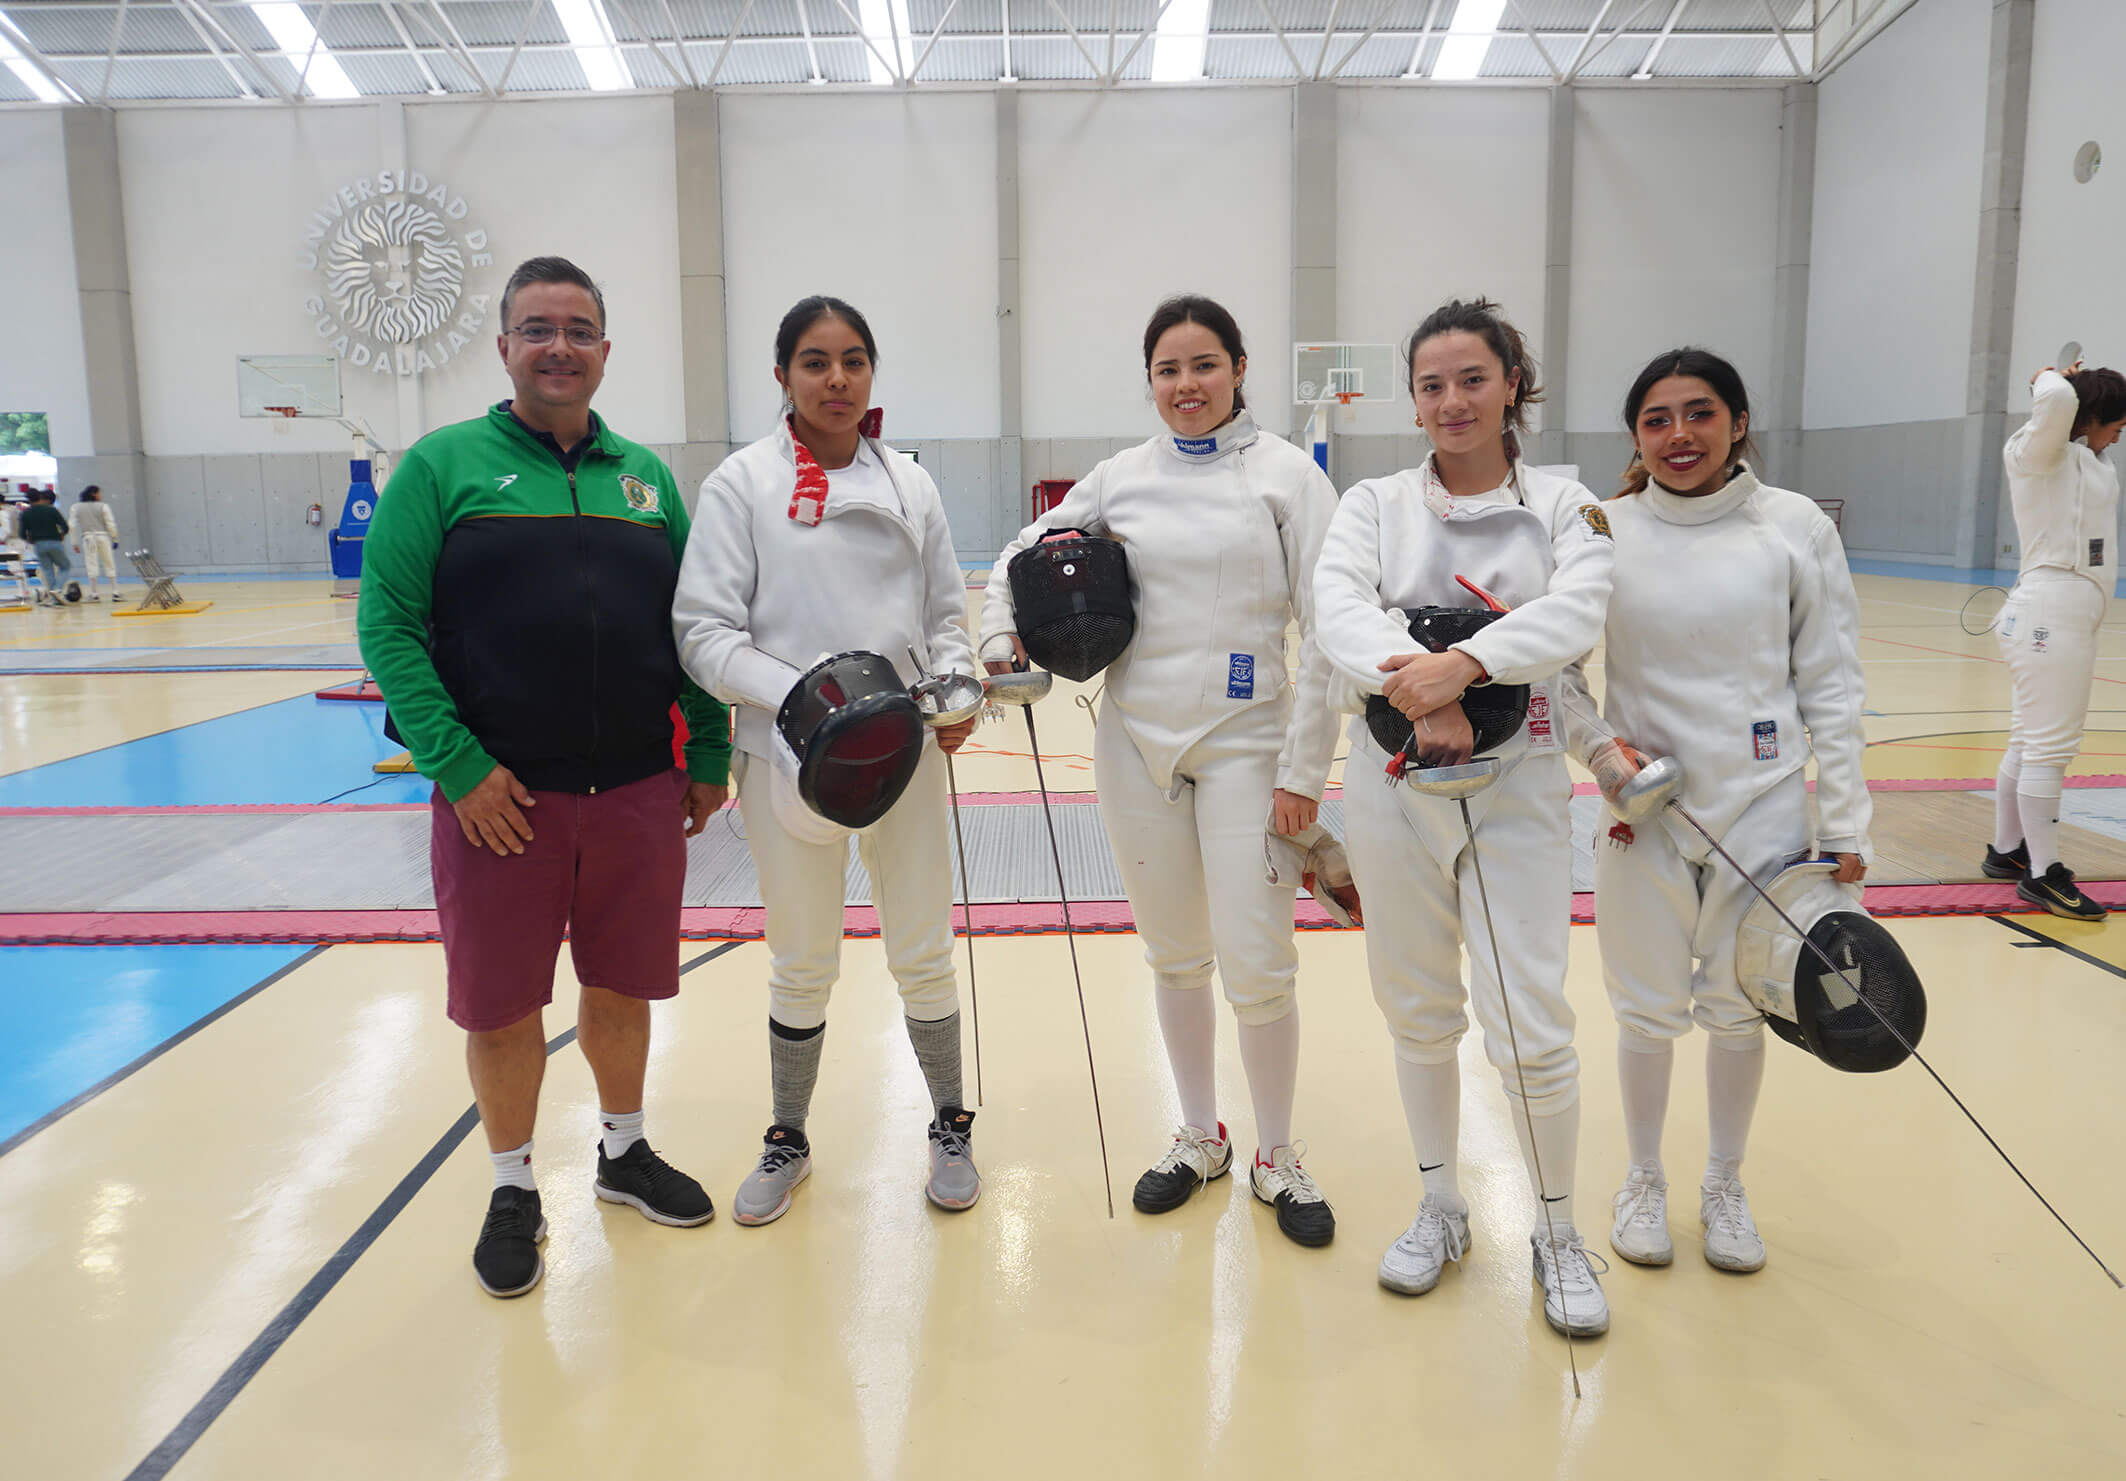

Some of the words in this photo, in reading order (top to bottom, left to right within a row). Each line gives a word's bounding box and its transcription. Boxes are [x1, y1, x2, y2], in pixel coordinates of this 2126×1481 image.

[297, 169, 468, 271] UNIVERSIDAD
[464, 228, 493, 268] DE
[303, 294, 491, 376] GUADALAJARA
